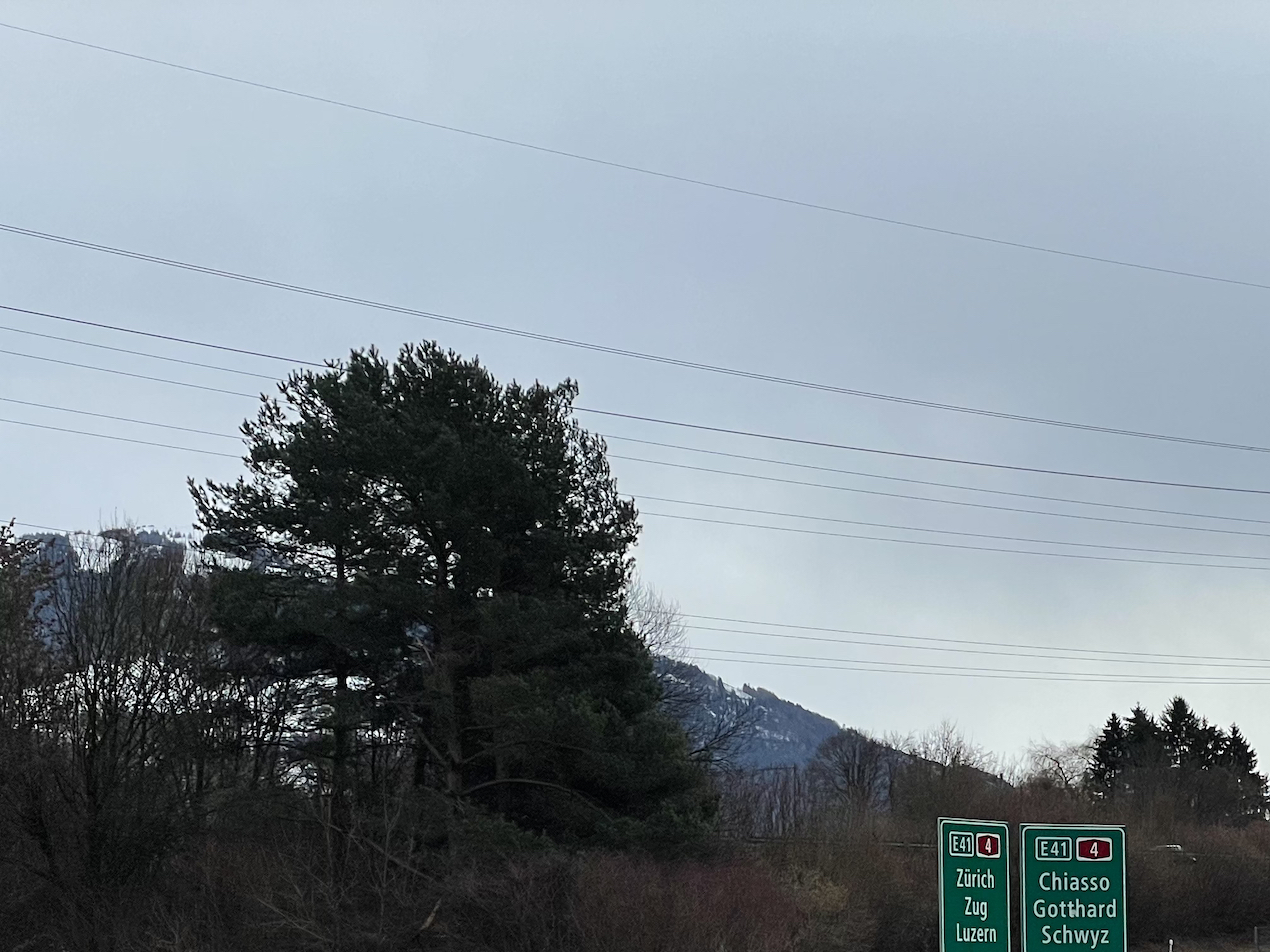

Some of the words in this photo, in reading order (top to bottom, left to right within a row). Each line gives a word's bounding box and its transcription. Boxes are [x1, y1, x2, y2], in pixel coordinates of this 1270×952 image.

[952, 836, 971, 853] E41
[984, 838, 992, 854] 4
[1040, 840, 1067, 857] E41
[1089, 841, 1099, 857] 4
[956, 868, 995, 889] Zürich
[1038, 871, 1110, 891] Chiasso
[964, 896, 988, 921] Zug
[1033, 898, 1117, 918] Gotthard
[956, 923, 997, 943] Luzern
[1041, 924, 1110, 949] Schwyz
